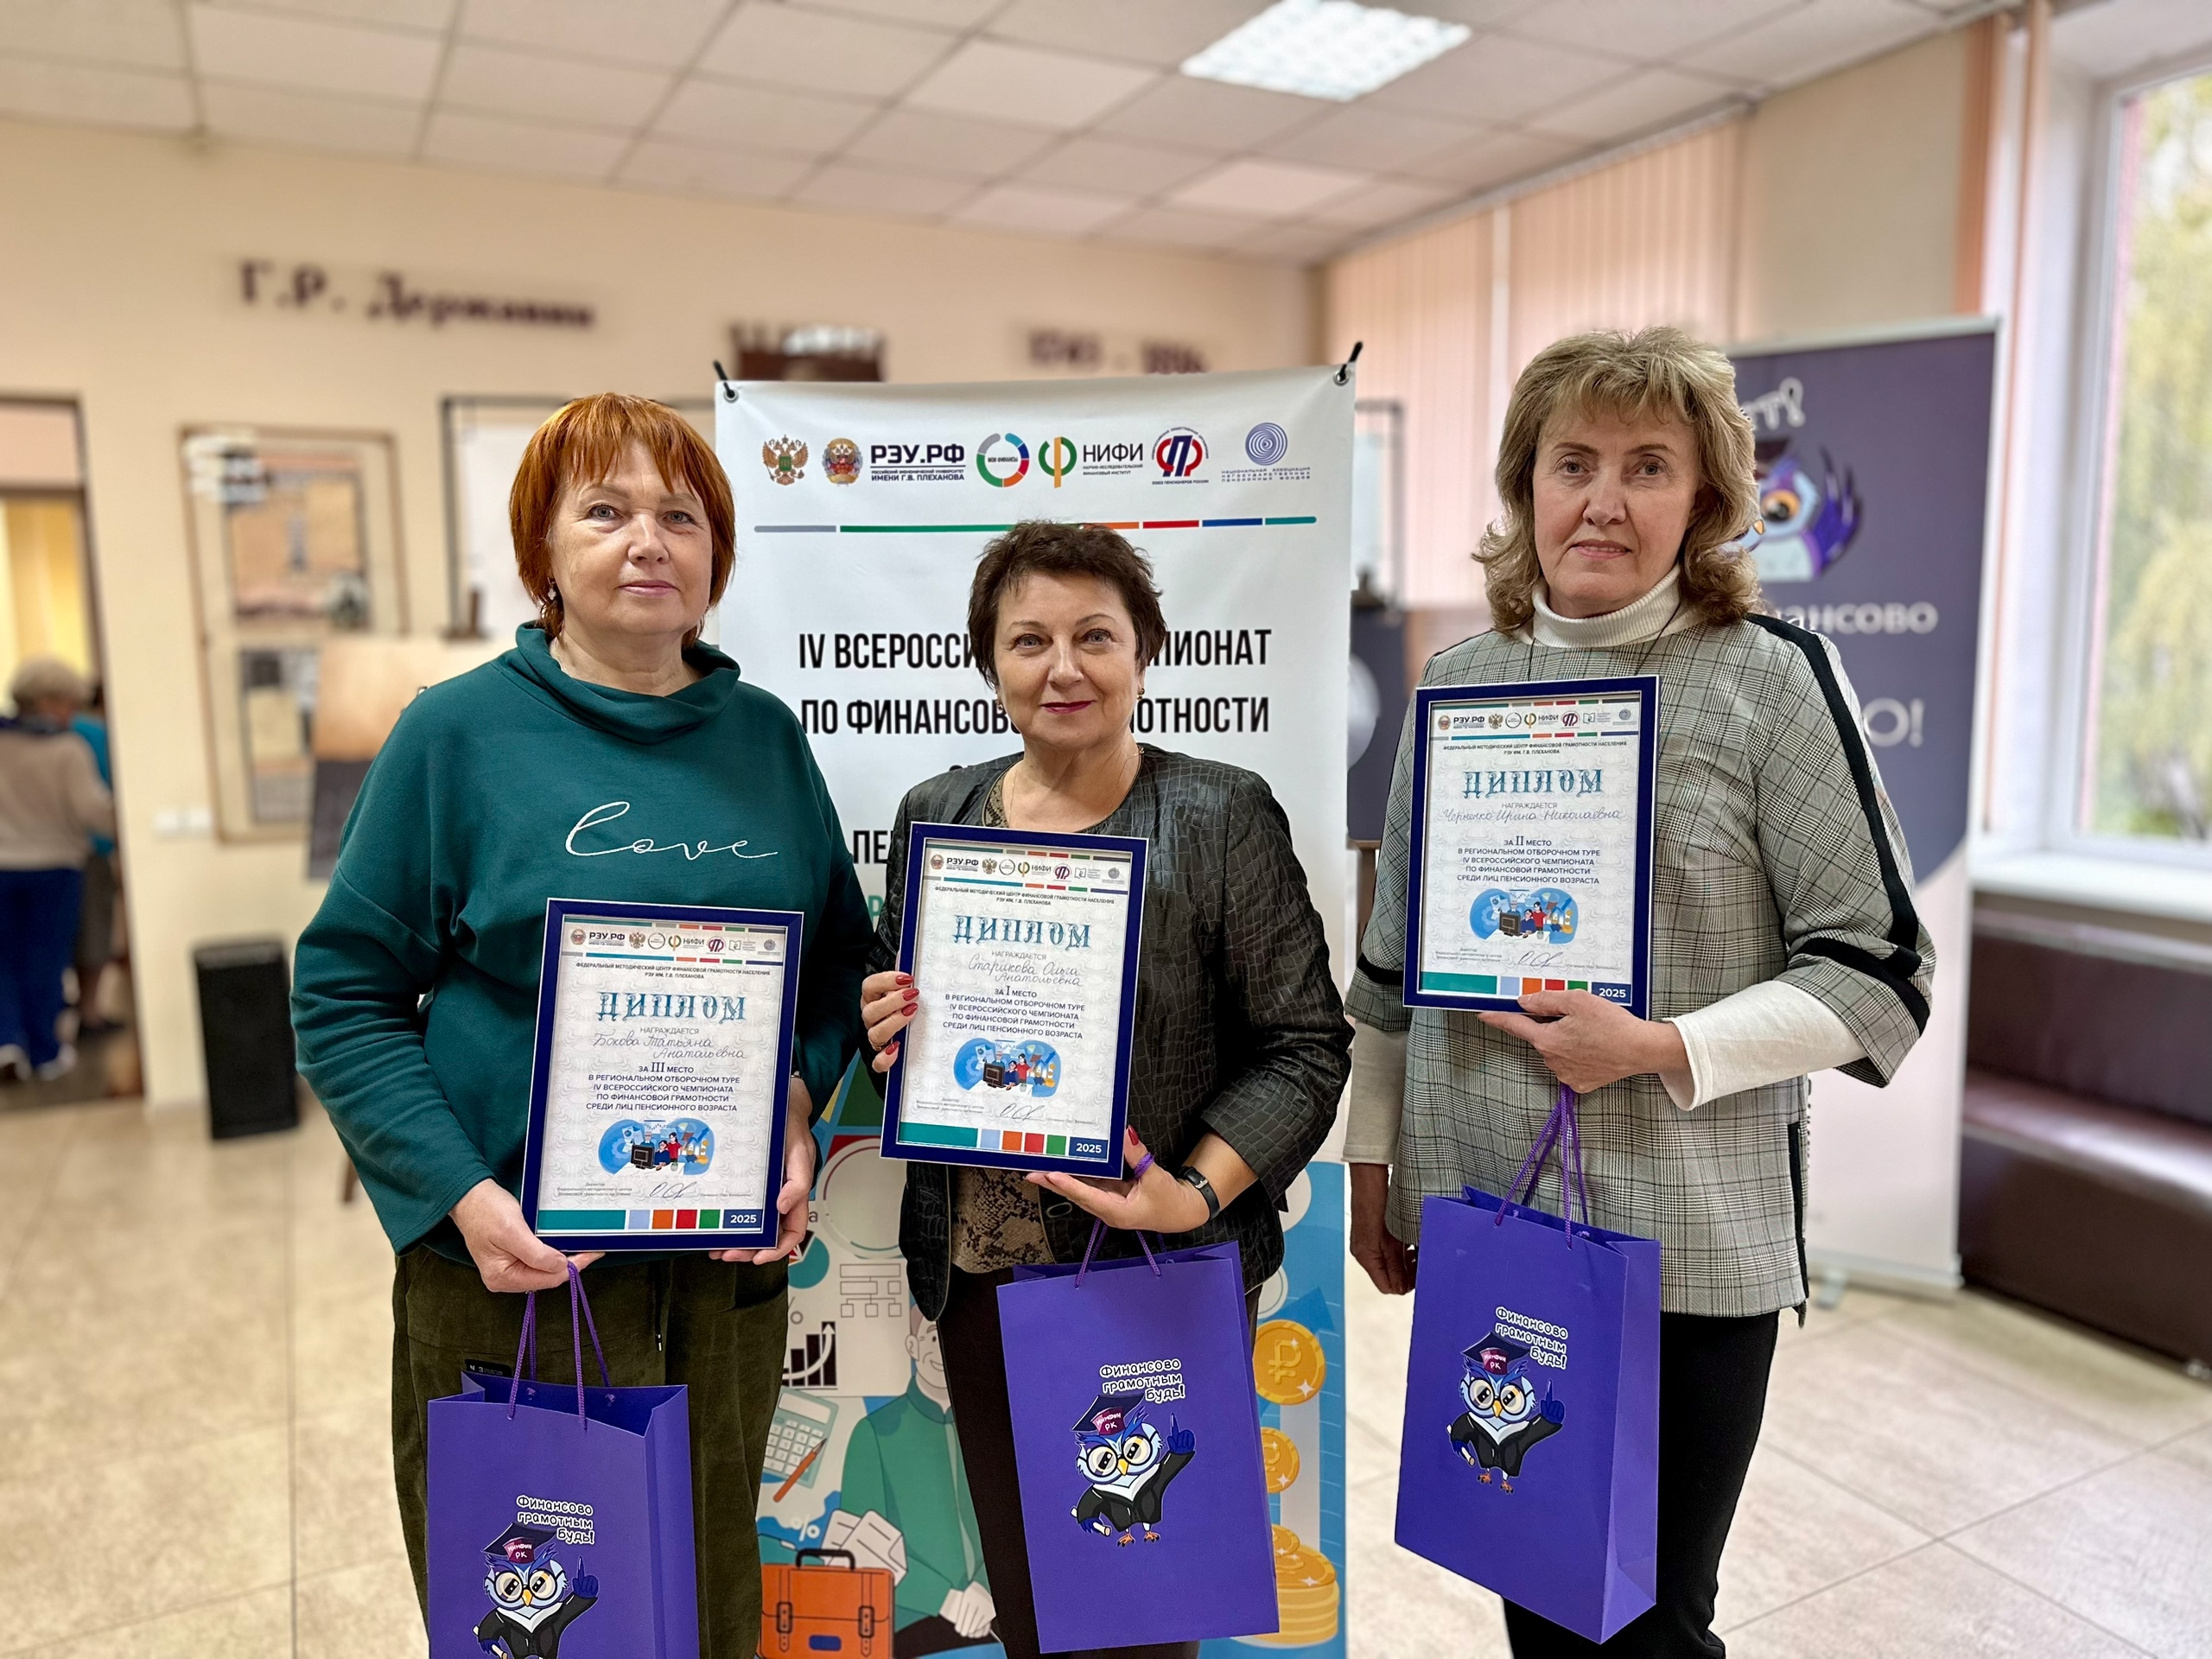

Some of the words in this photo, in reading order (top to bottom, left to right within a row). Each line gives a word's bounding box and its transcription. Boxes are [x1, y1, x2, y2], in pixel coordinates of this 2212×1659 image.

[871, 443, 964, 464] РЭУ.РФ
[1083, 443, 1143, 462] НИФИ
[799, 633, 825, 669] IV
[835, 632, 977, 669] ВСЕРОССИ
[1149, 629, 1272, 667] ПИОНАТ
[802, 699, 838, 734] ПО
[847, 699, 1020, 734] ФИНАНСОВ
[1132, 696, 1269, 734] ОТНОСТИ
[1453, 715, 1485, 724] РЭУ.РФ
[1462, 769, 1603, 799] ДИПЛОМ
[1496, 810, 1537, 823] Ирина
[1543, 807, 1622, 820] Николаевна
[1516, 836, 1524, 846] II
[946, 857, 979, 867] РЭУ.РФ
[1471, 856, 1541, 865] ВСЕРОССИЙСКОГО
[1478, 865, 1532, 874] ФИНАНСОВОЙ
[588, 931, 626, 940] РЭУ.РФ
[952, 914, 1091, 951] ДИПЛОМ
[992, 950, 1046, 961] НАГРАЖДАЕТСЯ
[969, 953, 1037, 976] Старикова
[1042, 961, 1079, 976] Ольга
[995, 972, 1084, 987] Анатольевна
[1006, 985, 1011, 996] I
[1599, 988, 1626, 999] 2025
[596, 991, 747, 1025] ДИПЛОМ
[951, 995, 1013, 1006] РЕГИОНАЛЬНОМ
[1014, 999, 1066, 1010] ОТБОРОЧНОМ
[958, 1004, 1027, 1016] ВСЕРОССИЙСКОГО
[1028, 1010, 1079, 1020] ЧЕМПИОНАТА
[964, 1014, 1019, 1025] ФИНАНСОВОЙ
[1020, 1018, 1075, 1028] ГРАМОТНОСТИ
[943, 1021, 968, 1031] СРЕДИ
[969, 1023, 986, 1032] ЛИЦ
[986, 1025, 1044, 1036] ПЕНСИОННОГО
[1046, 1029, 1084, 1039] ВОЗРАСТА
[593, 1029, 640, 1047] Бокова
[643, 1033, 714, 1048] Татьяна
[651, 1061, 665, 1073] III
[603, 1084, 679, 1092] ВСЕРОССИЙСКОГО
[610, 1093, 670, 1102] ФИНАНСОВОЙ
[586, 1103, 613, 1111] СРЕДИ
[615, 1103, 633, 1112] ЛИЦ
[697, 1103, 738, 1112] ВОЗРАСТА
[1076, 1142, 1103, 1154] 2025
[730, 1214, 757, 1224] 2025
[1496, 1306, 1567, 1338] Финансово
[1495, 1323, 1567, 1353] грамотным
[1100, 1358, 1181, 1378] Финансово
[1103, 1374, 1182, 1394] грамотным
[1104, 1422, 1118, 1432] РК
[517, 1496, 594, 1516] Финансово
[518, 1512, 594, 1529] грамотным
[515, 1550, 528, 1560] РК
